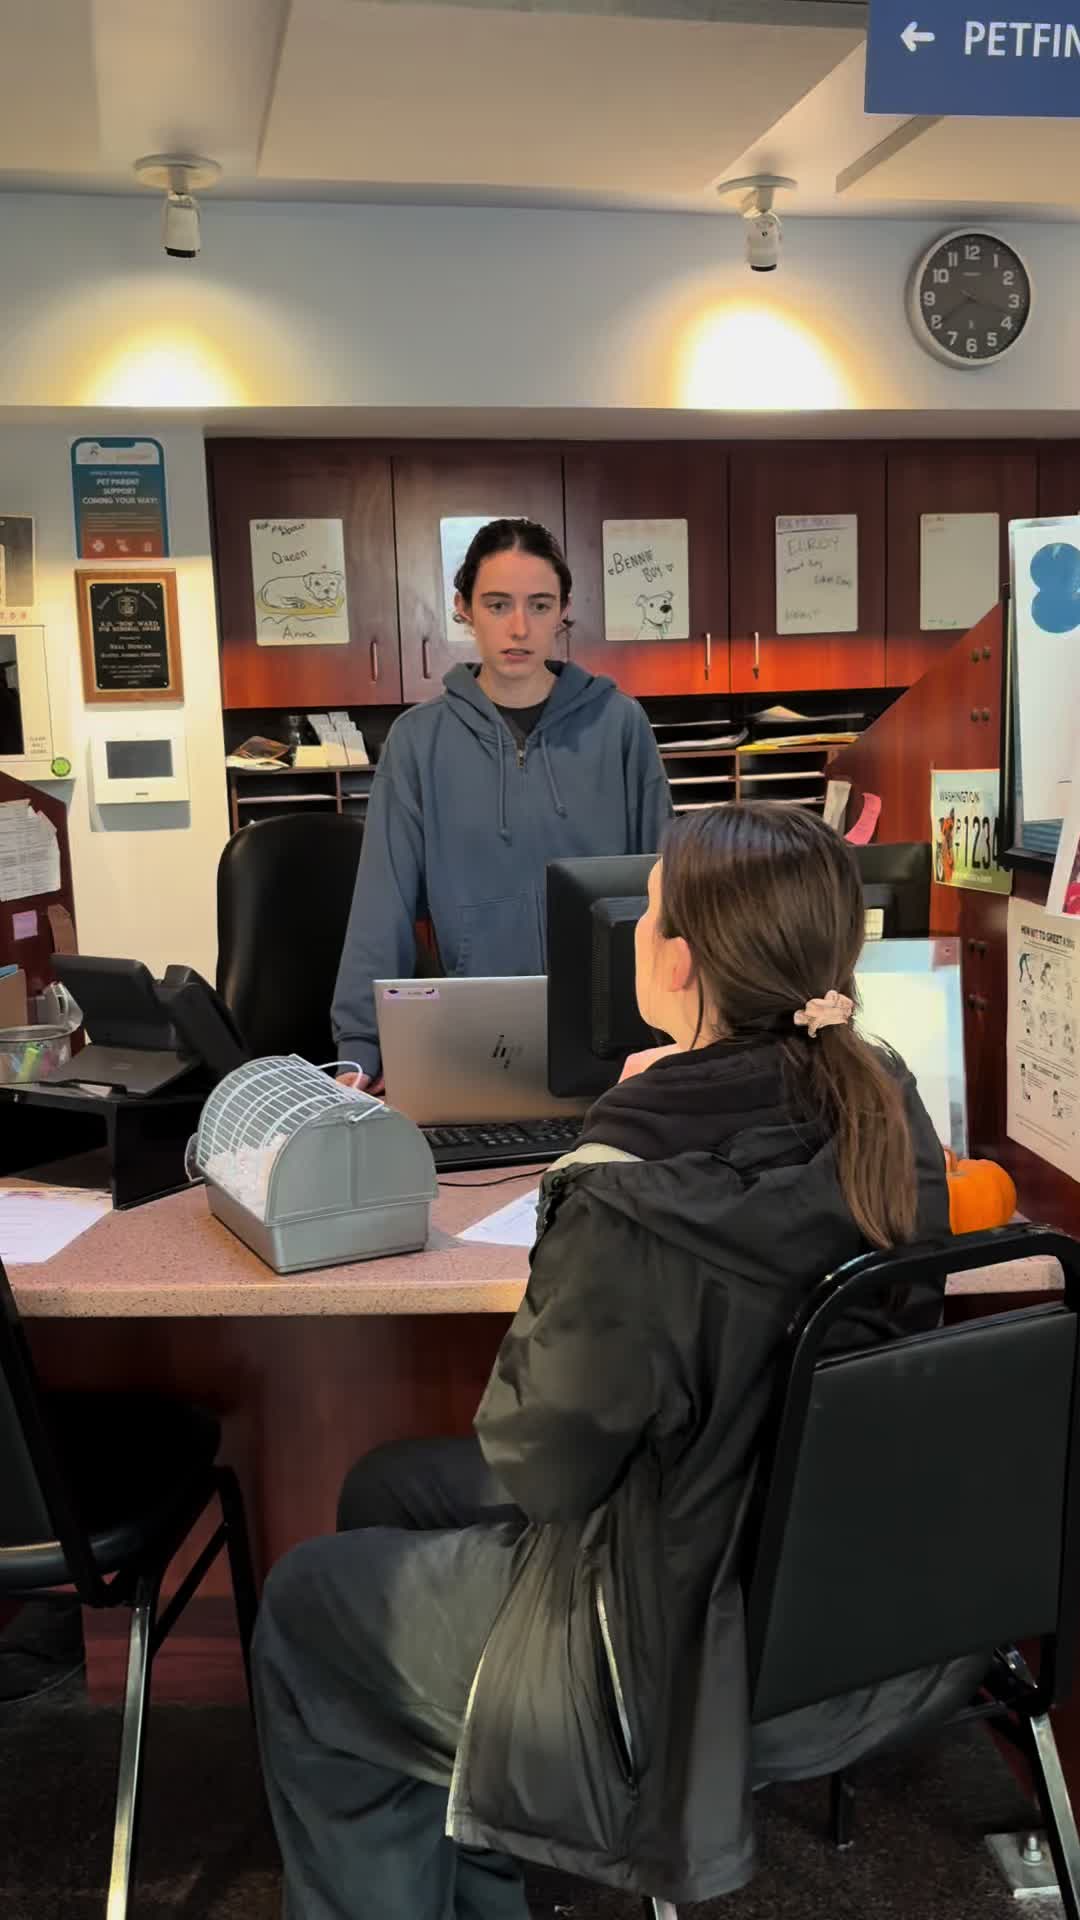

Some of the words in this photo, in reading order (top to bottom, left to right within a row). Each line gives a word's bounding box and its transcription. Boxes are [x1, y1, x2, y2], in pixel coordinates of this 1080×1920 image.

[948, 252, 958, 267] 11
[965, 245, 981, 261] 12
[993, 254, 999, 268] 1
[933, 269, 950, 284] 10
[1003, 271, 1015, 286] 2
[924, 291, 936, 306] 9
[1009, 294, 1020, 309] 3
[931, 315, 943, 330] 8
[1001, 317, 1013, 331] 4
[947, 331, 958, 346] 7
[966, 338, 978, 353] 6
[987, 332, 998, 347] 5
[111, 478, 140, 486] PARENT
[103, 487, 136, 495] SUPPORT
[82, 496, 114, 505] COMING
[115, 496, 136, 505] YOUR
[939, 791, 981, 803] WASHINGTON
